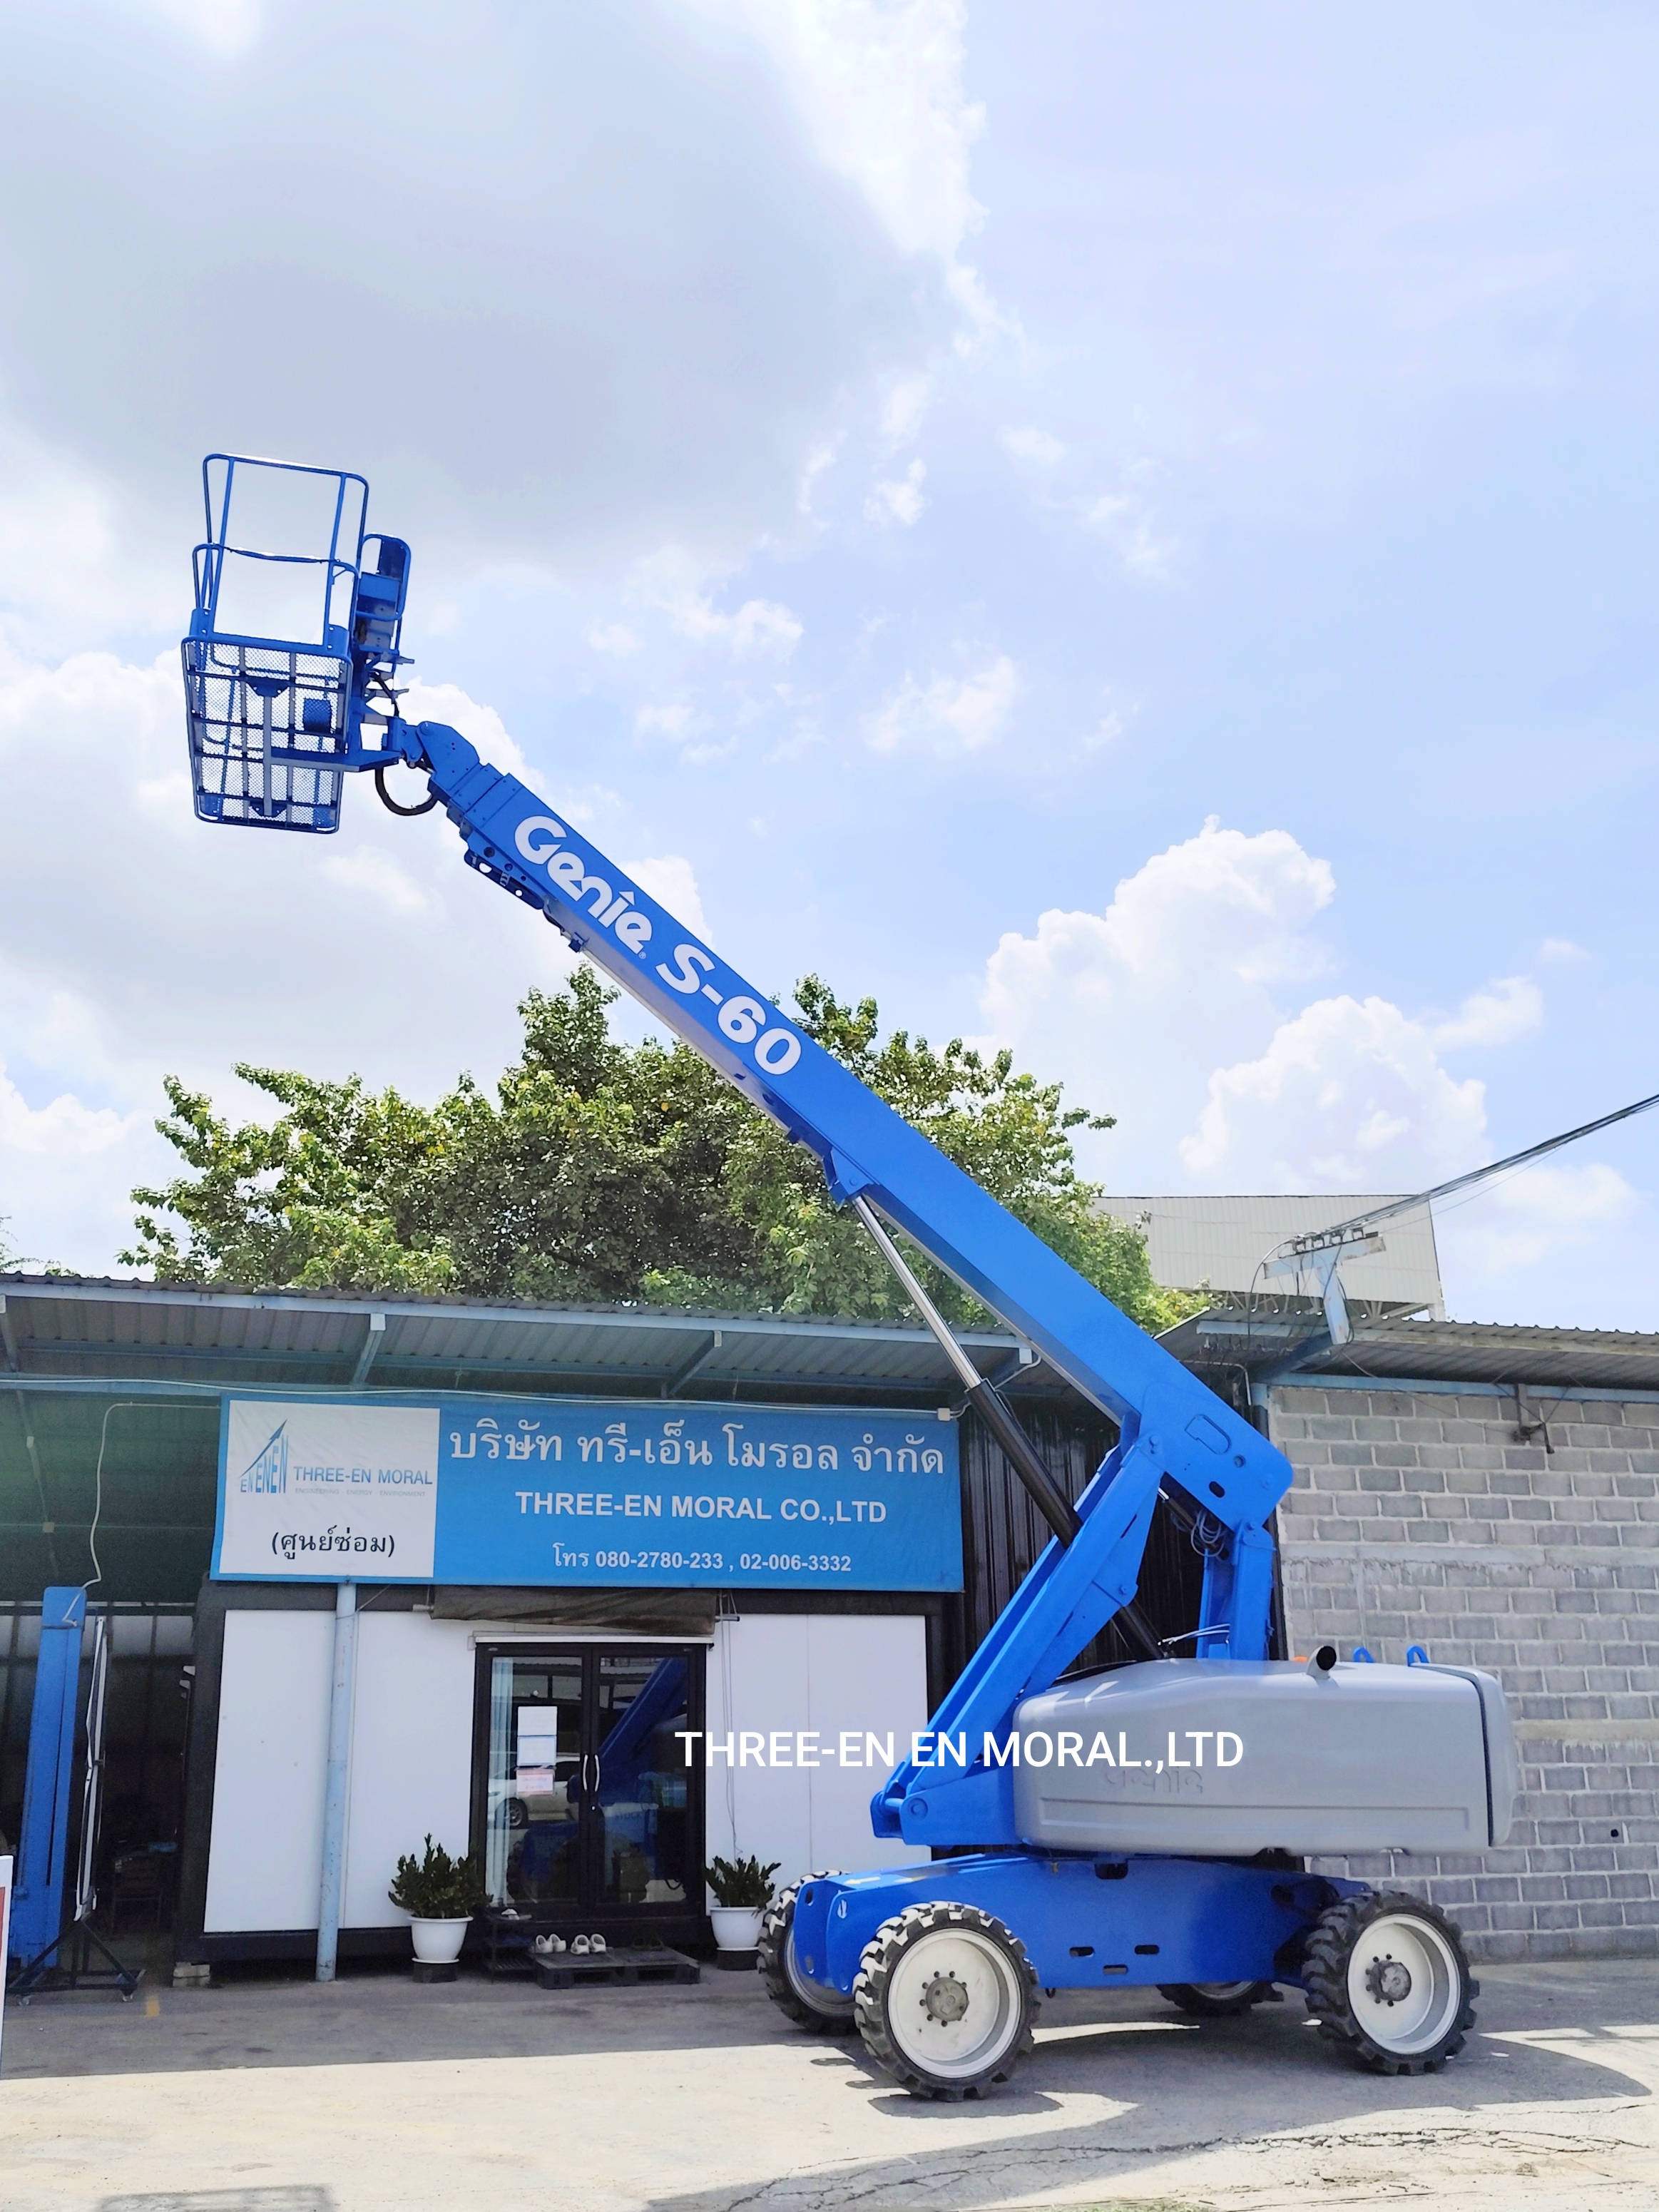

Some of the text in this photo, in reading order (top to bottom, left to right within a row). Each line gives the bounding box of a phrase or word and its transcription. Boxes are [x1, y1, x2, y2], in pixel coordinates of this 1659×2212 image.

[514, 815, 802, 1076] Genie S-60
[449, 1417, 944, 1474] บริษัท ทรี-เอ็น โมรอล จำกัด
[293, 1465, 433, 1485] THREE-EN MORAL
[515, 1491, 887, 1526] THREE-EN MORAL CO.,LTD
[271, 1524, 395, 1560] (ศูนย์ซ่อม)
[552, 1542, 590, 1567] โทร
[595, 1550, 724, 1569] 080-2780-233
[739, 1553, 852, 1572] 02-006-3332
